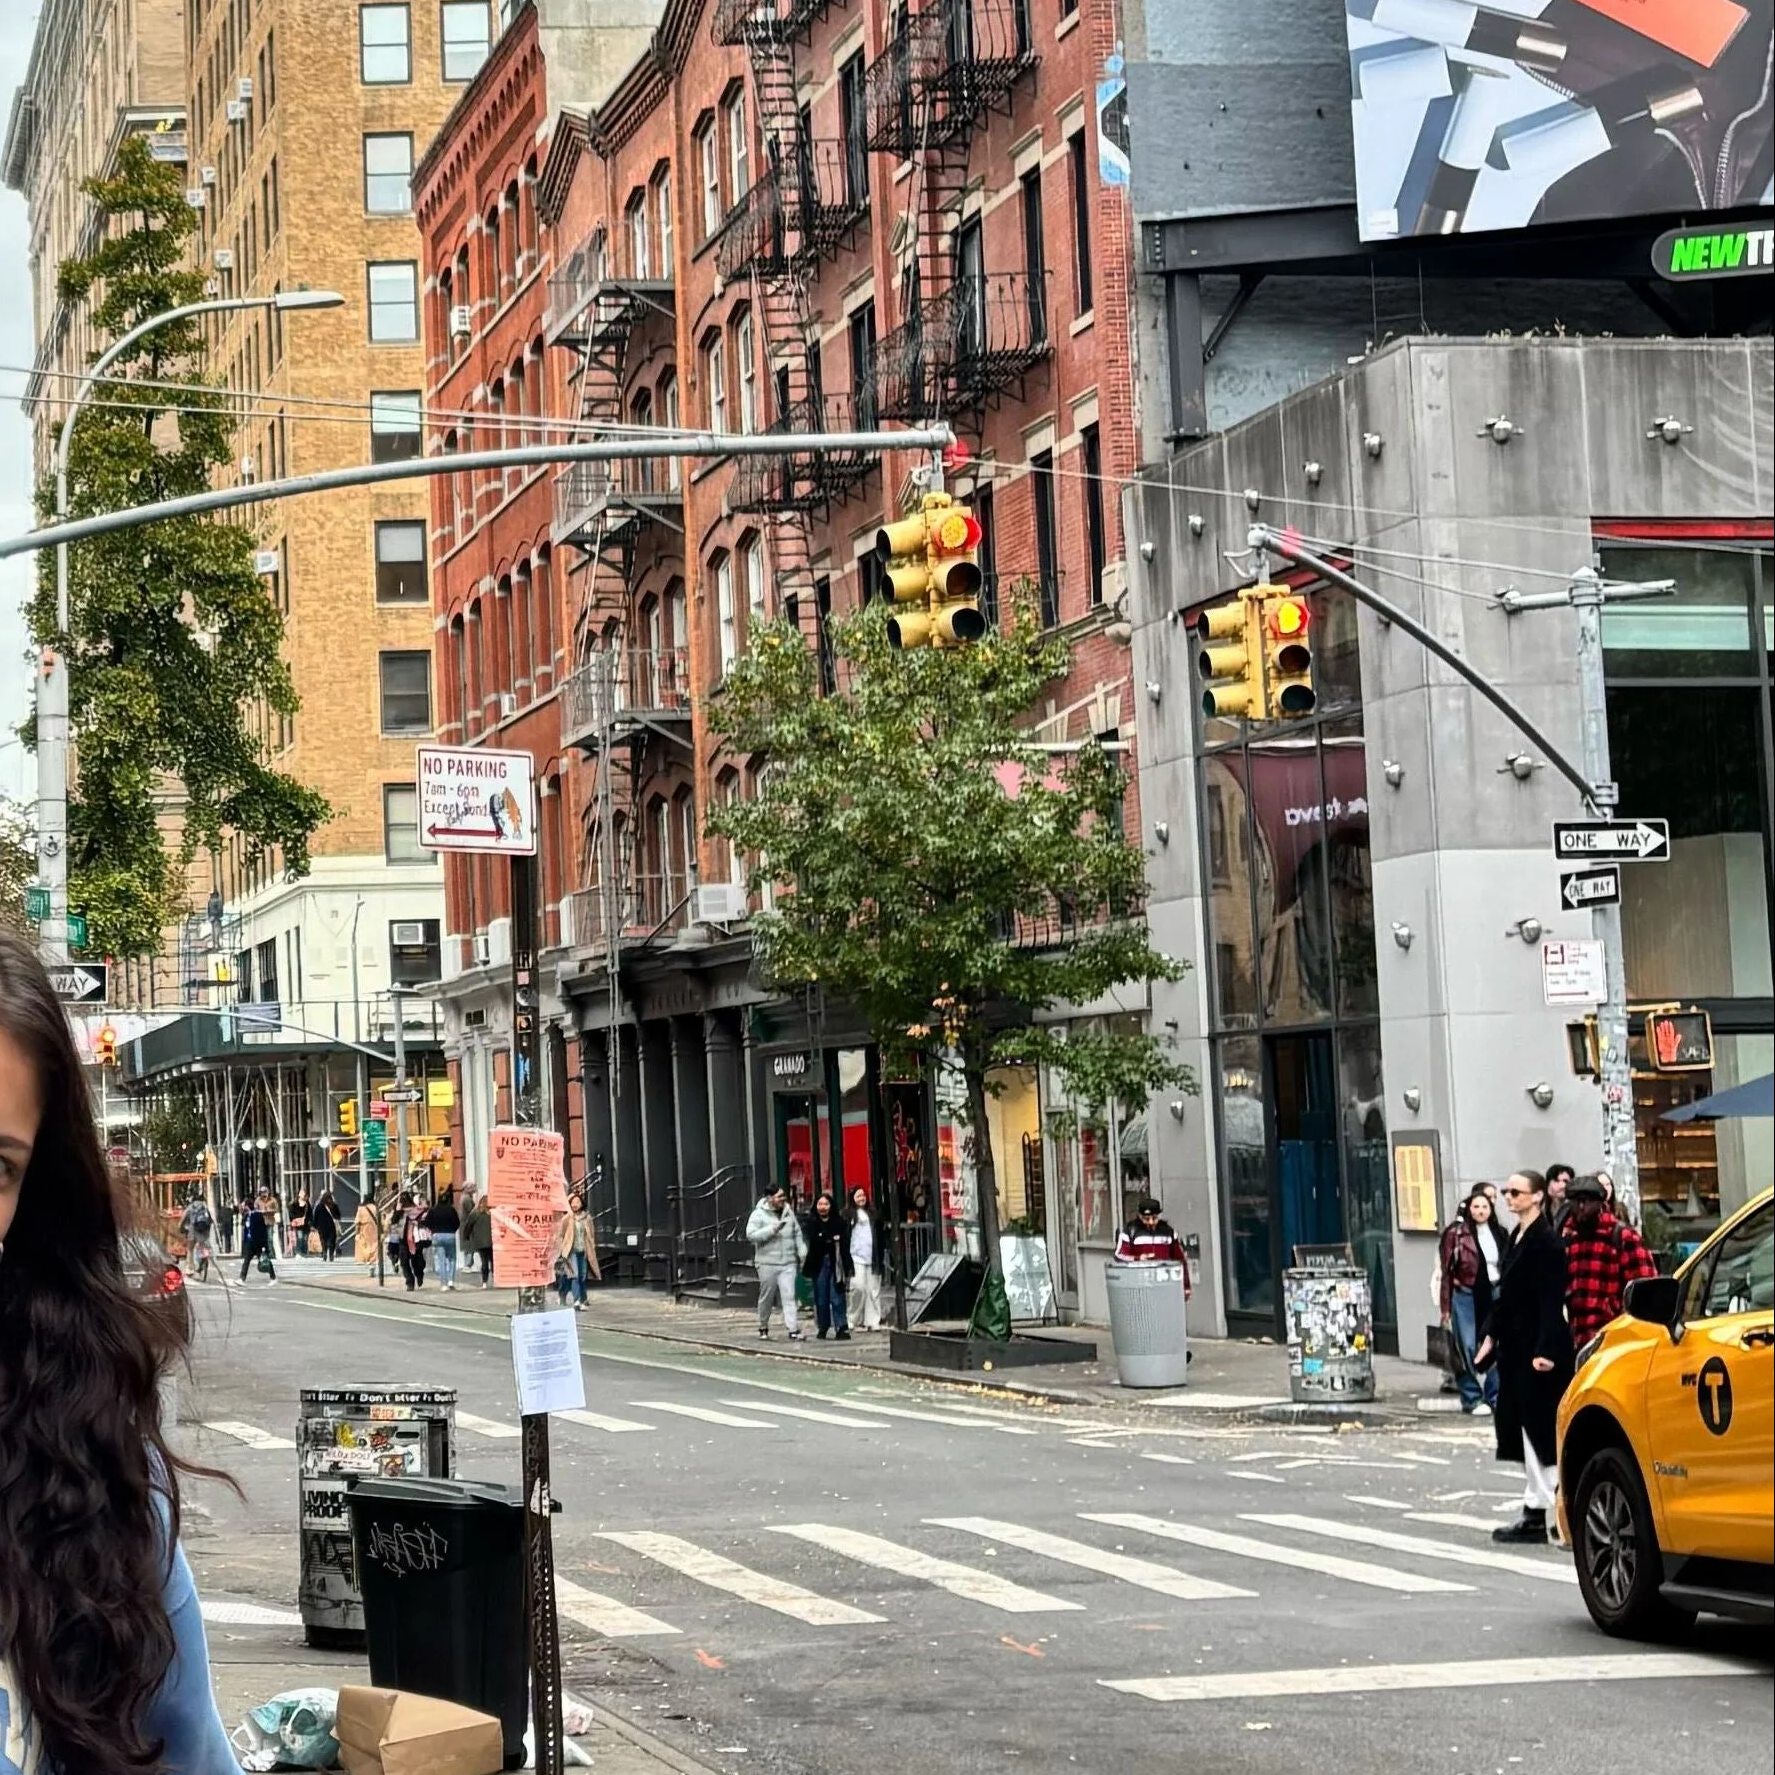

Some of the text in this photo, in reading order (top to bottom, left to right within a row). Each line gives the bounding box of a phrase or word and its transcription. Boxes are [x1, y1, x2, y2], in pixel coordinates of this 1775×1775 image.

[423, 757, 507, 779] NO PARKING
[1564, 833, 1651, 848] ONE WAY
[1569, 880, 1610, 899] ONE WAY
[55, 976, 89, 994] WAY
[501, 1136, 519, 1146] NO
[1705, 1372, 1724, 1425] T
